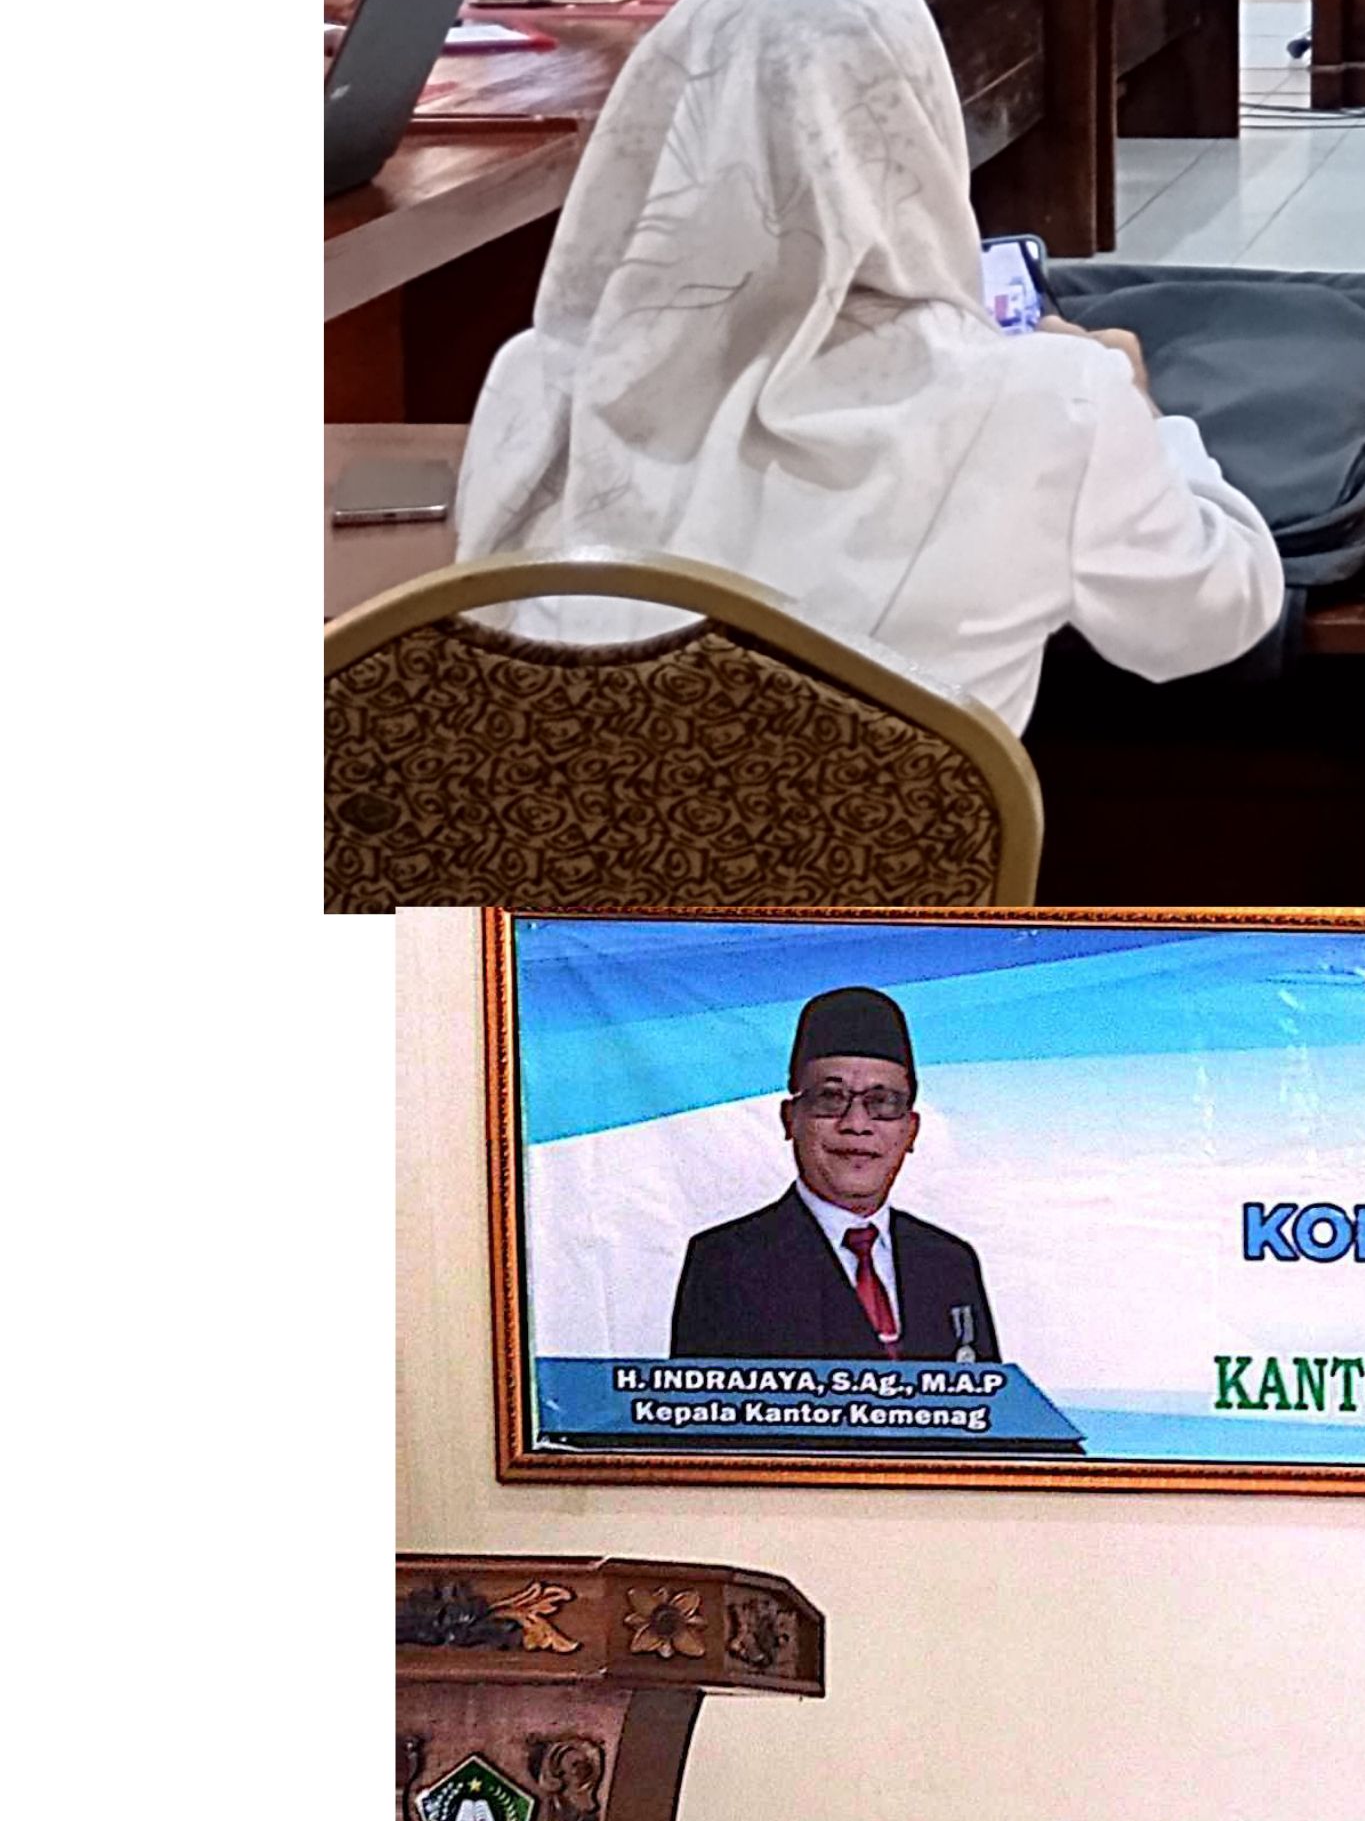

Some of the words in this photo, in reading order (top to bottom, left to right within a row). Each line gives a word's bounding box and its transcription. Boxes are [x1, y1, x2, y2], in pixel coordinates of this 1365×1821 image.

[617, 1369, 645, 1390] H.
[654, 1369, 825, 1395] INDRAJAYA,
[832, 1372, 913, 1396] S.Ag.,
[922, 1373, 1003, 1393] M.A.P
[636, 1401, 737, 1425] Kepala
[745, 1403, 840, 1424] Kantor
[849, 1404, 988, 1430] Kemenag
